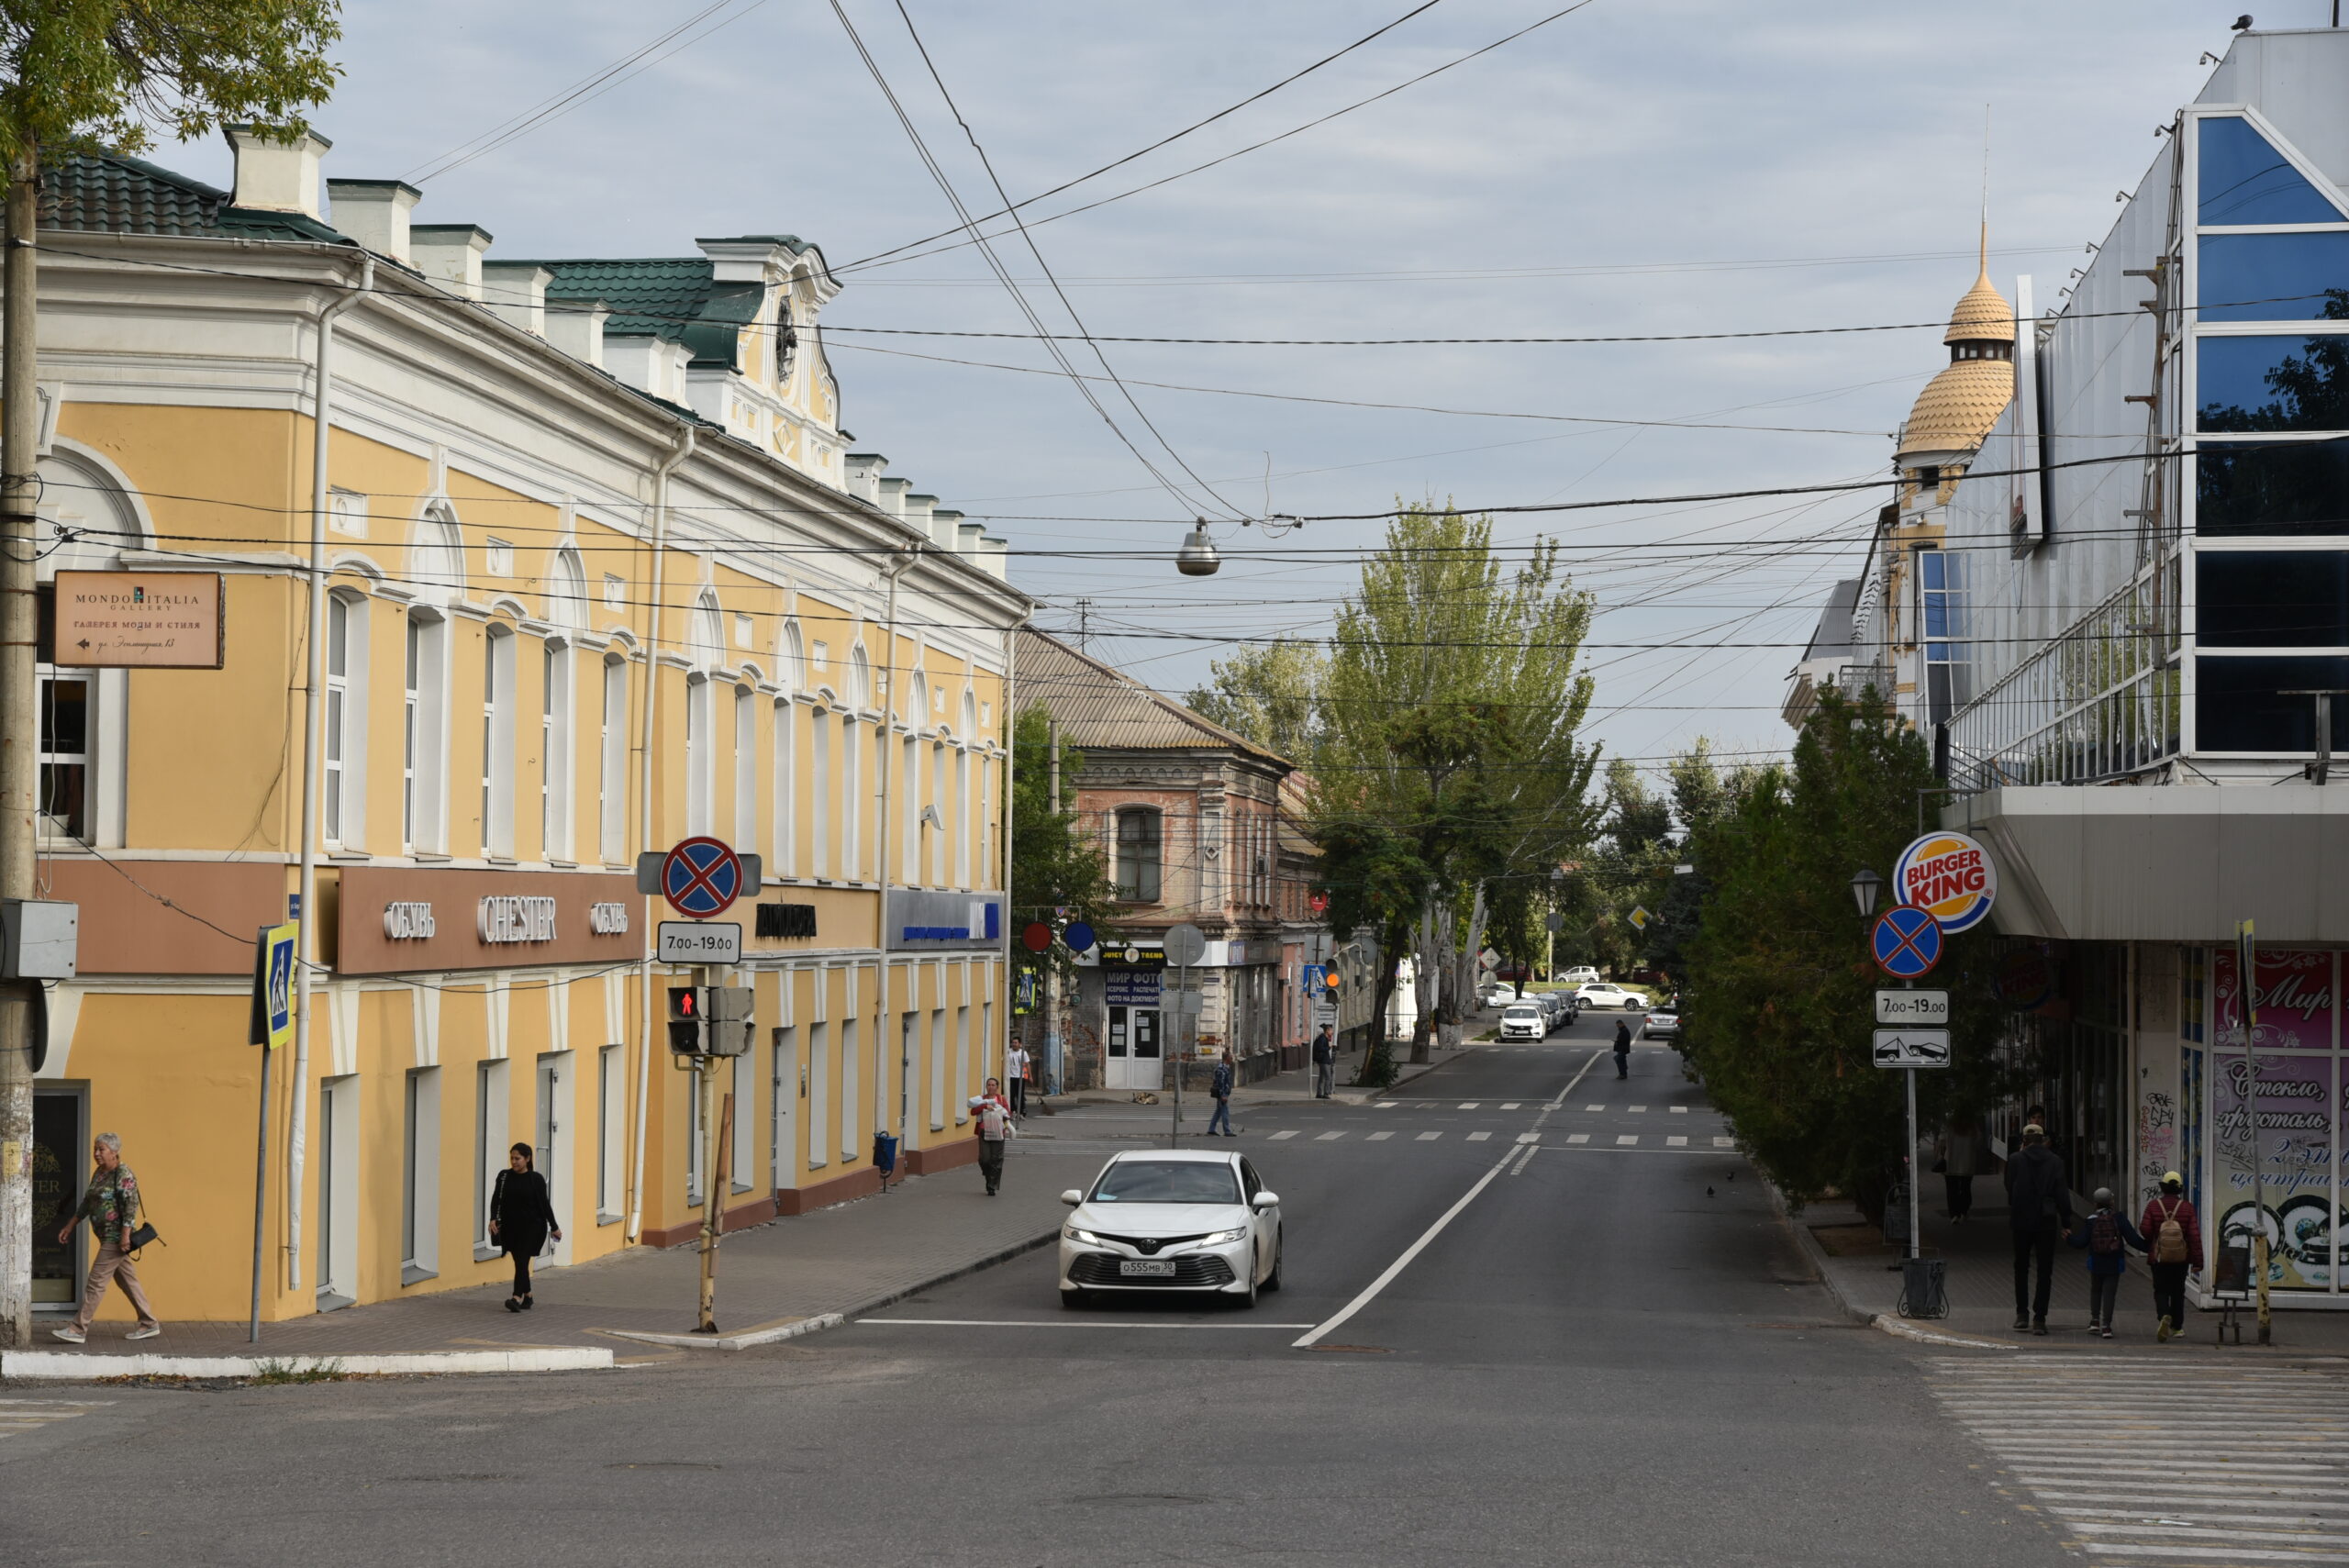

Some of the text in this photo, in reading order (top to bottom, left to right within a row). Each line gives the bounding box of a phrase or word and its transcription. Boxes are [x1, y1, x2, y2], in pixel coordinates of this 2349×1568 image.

[75, 595, 199, 605] MONDO ITALIA
[164, 638, 175, 648] 13
[1907, 850, 1985, 906] BURGER KING
[384, 901, 435, 939] ОБУВЬ
[477, 895, 557, 943] CHESTER
[590, 902, 629, 934] ОБУВЬ
[667, 935, 732, 951] 7.00-19.00
[1107, 973, 1130, 984] МИР
[1130, 995, 1159, 1003] ДОКУМЕНТ
[1133, 985, 1159, 994] РАСПЕЧАТ
[2254, 973, 2332, 1021] Мир
[1883, 997, 1946, 1013] 7.00-19.00
[2230, 1062, 2326, 1102] Стекло,
[2267, 1138, 2291, 1163] 2
